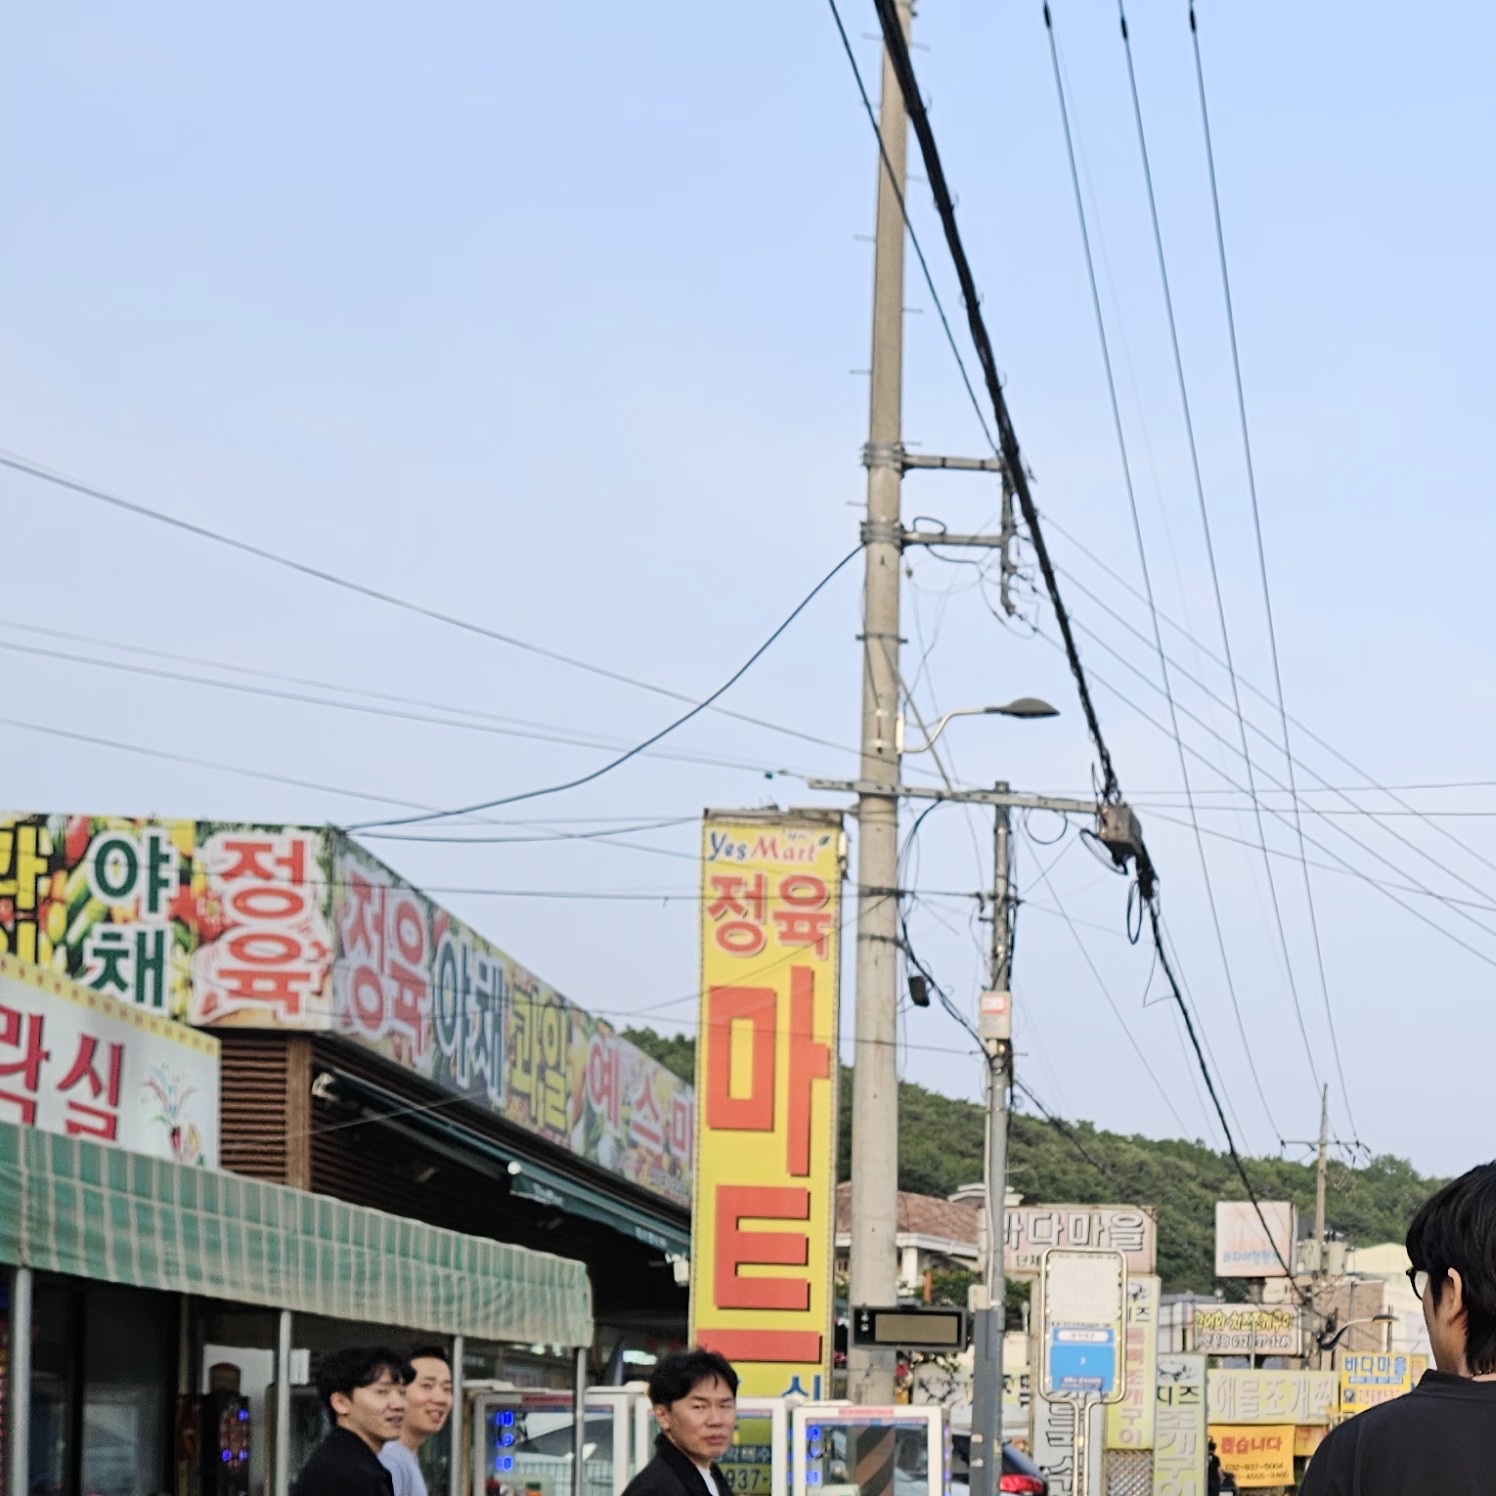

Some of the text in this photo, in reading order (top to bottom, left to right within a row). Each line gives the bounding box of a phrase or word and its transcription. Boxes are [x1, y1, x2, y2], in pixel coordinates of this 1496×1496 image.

[92, 835, 171, 1009] 야채
[217, 839, 311, 1015] 정육
[707, 872, 834, 958] 정육
[708, 831, 817, 863] Yes Mart
[697, 965, 832, 1364] 마트
